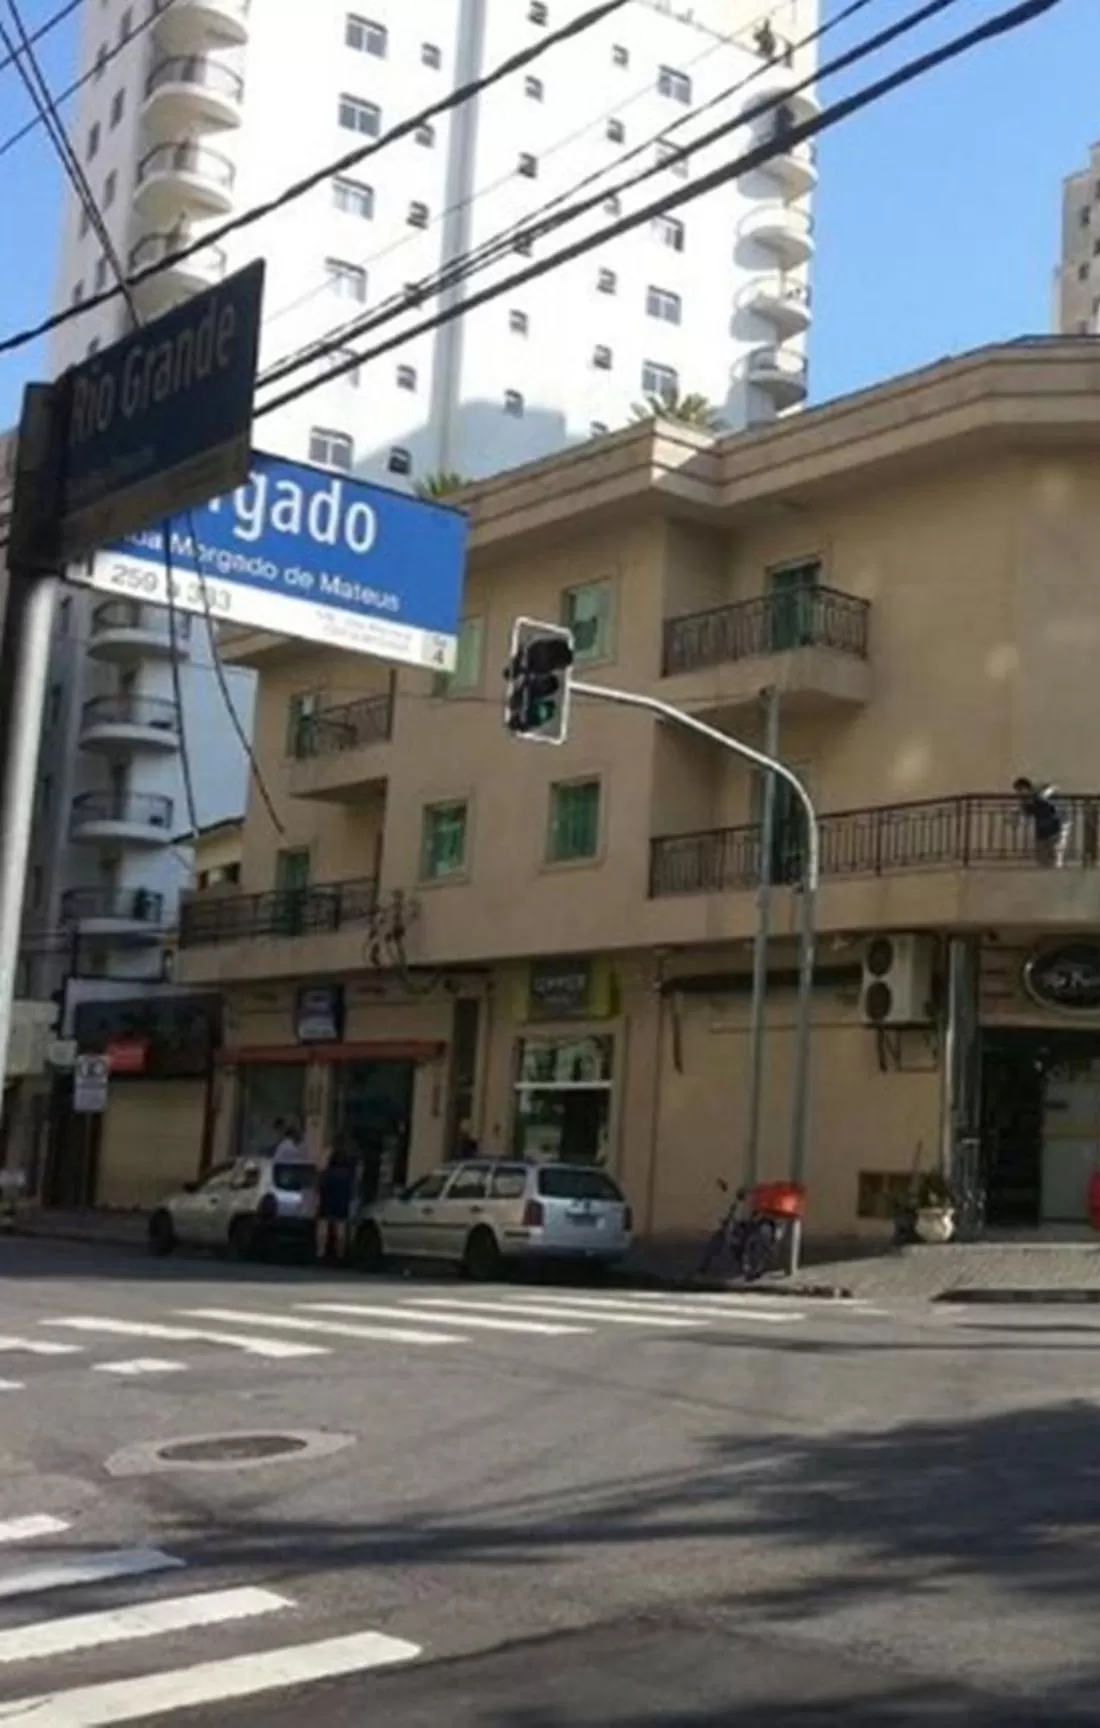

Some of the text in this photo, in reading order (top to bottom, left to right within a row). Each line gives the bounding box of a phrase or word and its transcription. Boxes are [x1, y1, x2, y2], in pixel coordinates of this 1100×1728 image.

[70, 298, 235, 446] Rio Grande
[208, 472, 377, 554] gado
[124, 528, 163, 550] ua
[284, 566, 314, 588] de
[320, 571, 399, 613] Mateus
